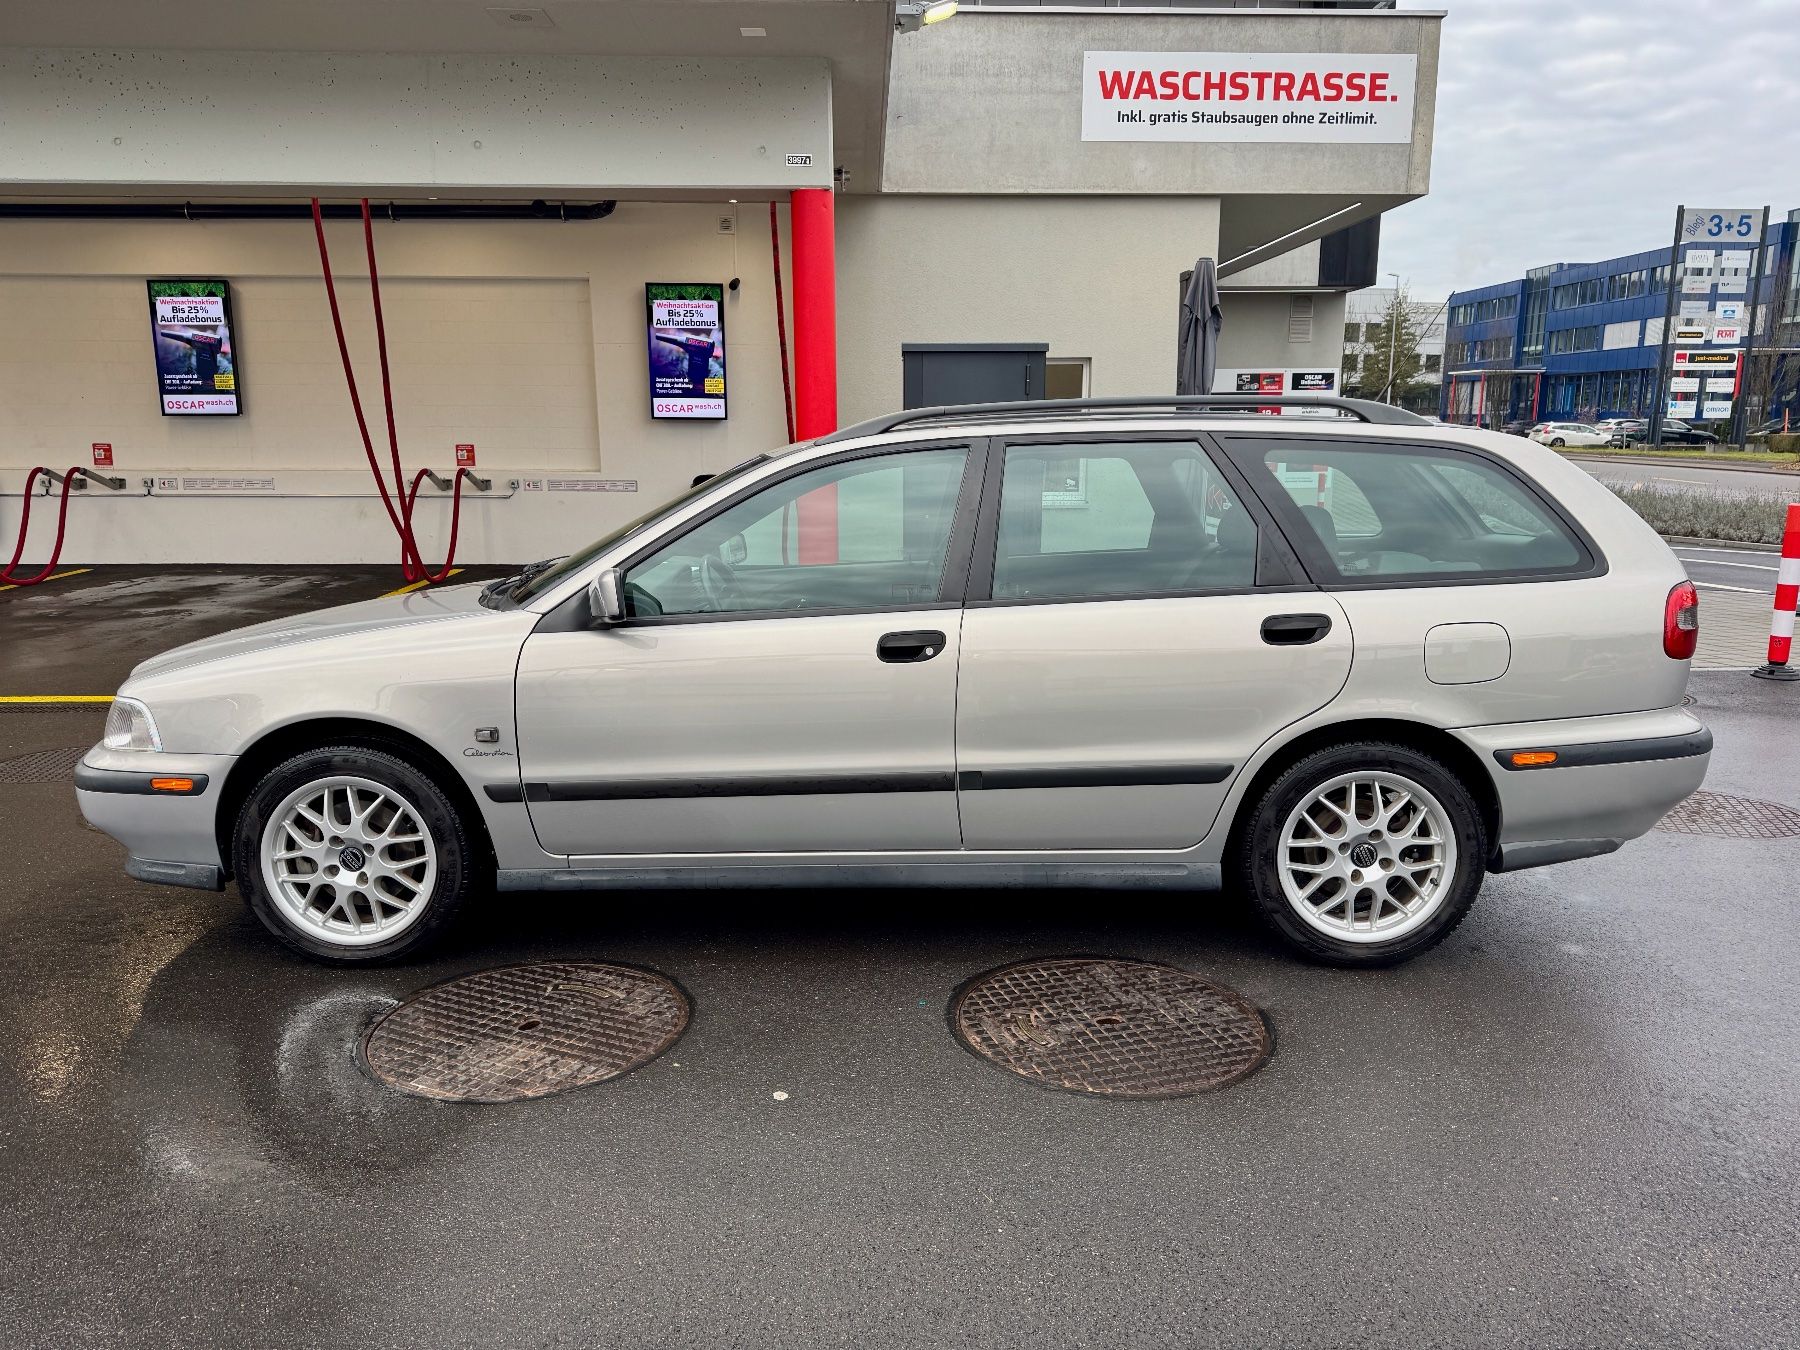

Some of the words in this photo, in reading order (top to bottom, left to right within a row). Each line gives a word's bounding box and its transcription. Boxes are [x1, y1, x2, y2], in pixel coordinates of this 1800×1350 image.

[1099, 70, 1398, 101] WASCHSTRASSE.
[1117, 110, 1146, 123] Inkl.
[1149, 112, 1188, 126] gratis
[1191, 111, 1278, 127] Staubsaugen
[1282, 112, 1315, 124] ohne
[1318, 112, 1377, 125] Zeitlimit.
[1685, 214, 1706, 236] Blegi
[172, 306, 186, 314] Bis
[667, 309, 682, 318] Bis
[160, 315, 222, 323] Aufladebonus
[655, 318, 717, 327] Aufladebonus
